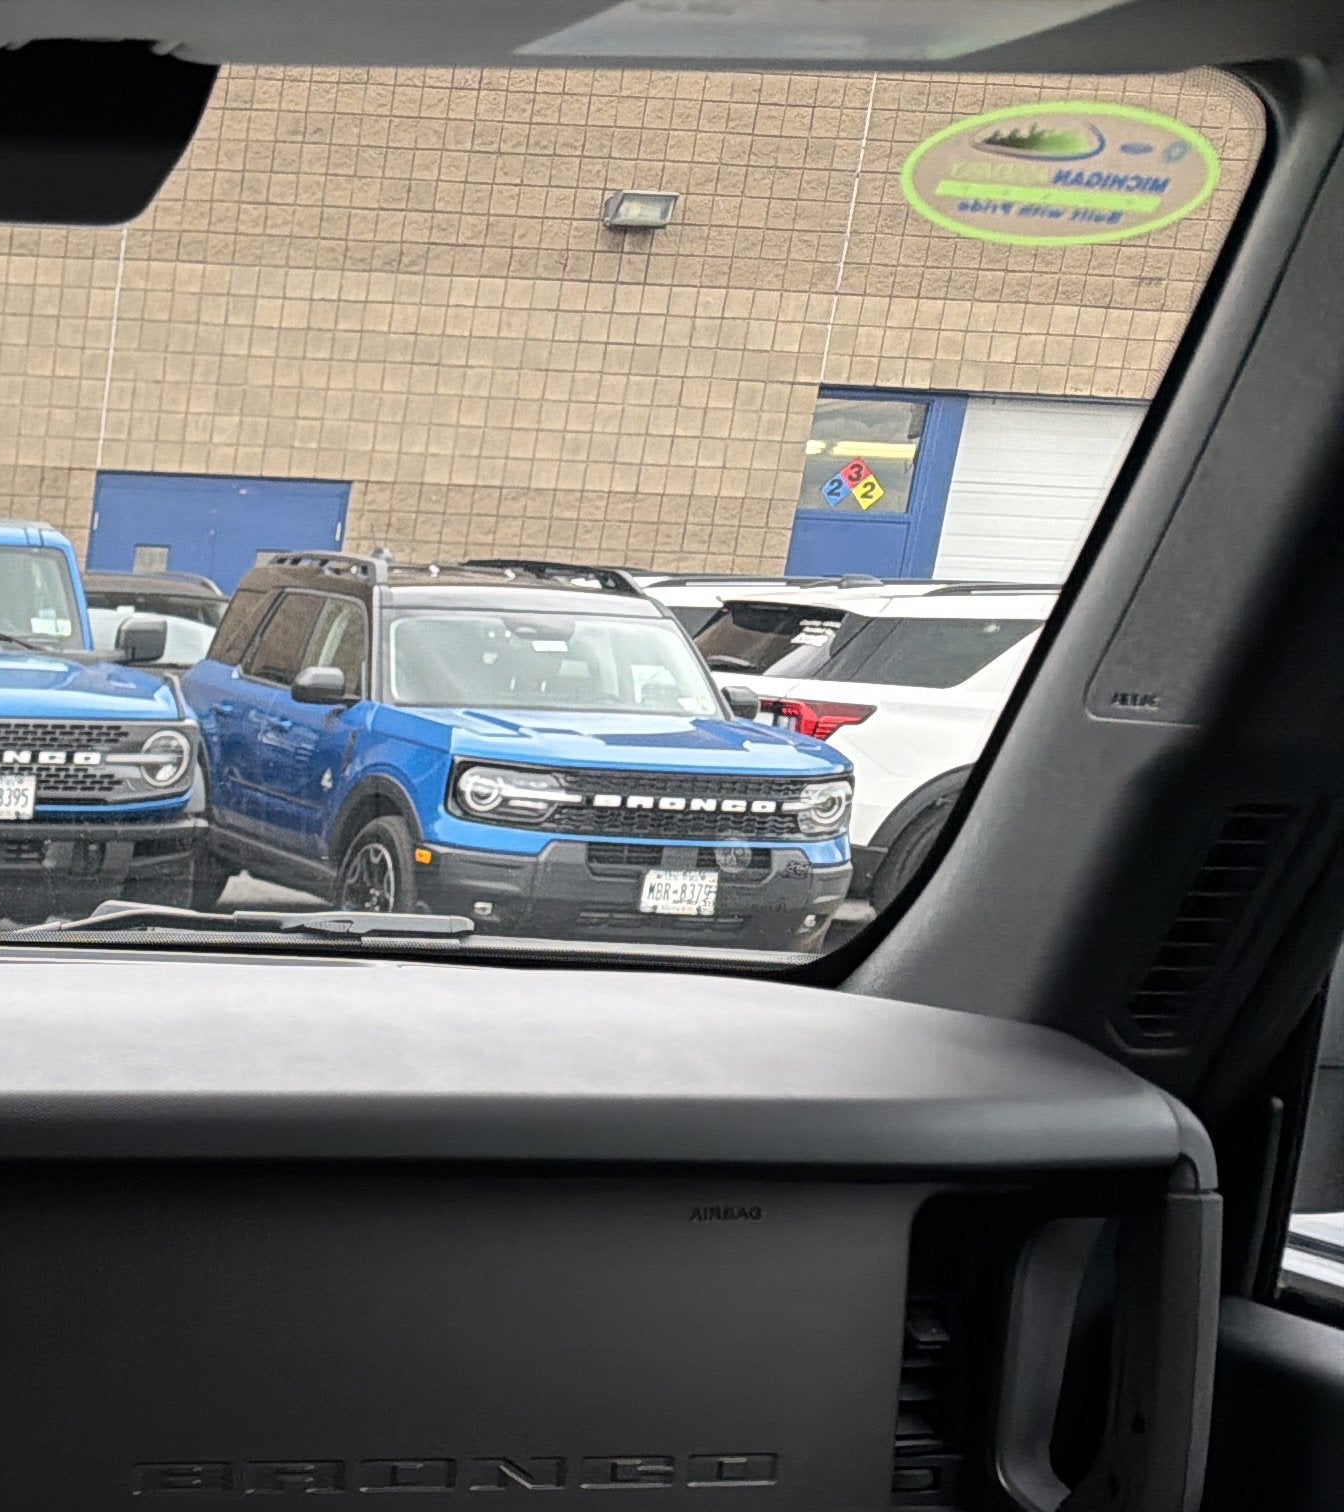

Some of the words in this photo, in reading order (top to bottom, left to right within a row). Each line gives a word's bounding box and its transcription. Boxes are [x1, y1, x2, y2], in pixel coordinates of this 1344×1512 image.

[847, 463, 864, 483] 3
[826, 478, 844, 498] 2
[859, 481, 877, 500] 2
[592, 794, 776, 814] BRONCO
[132, 1453, 779, 1496] BRONCO
